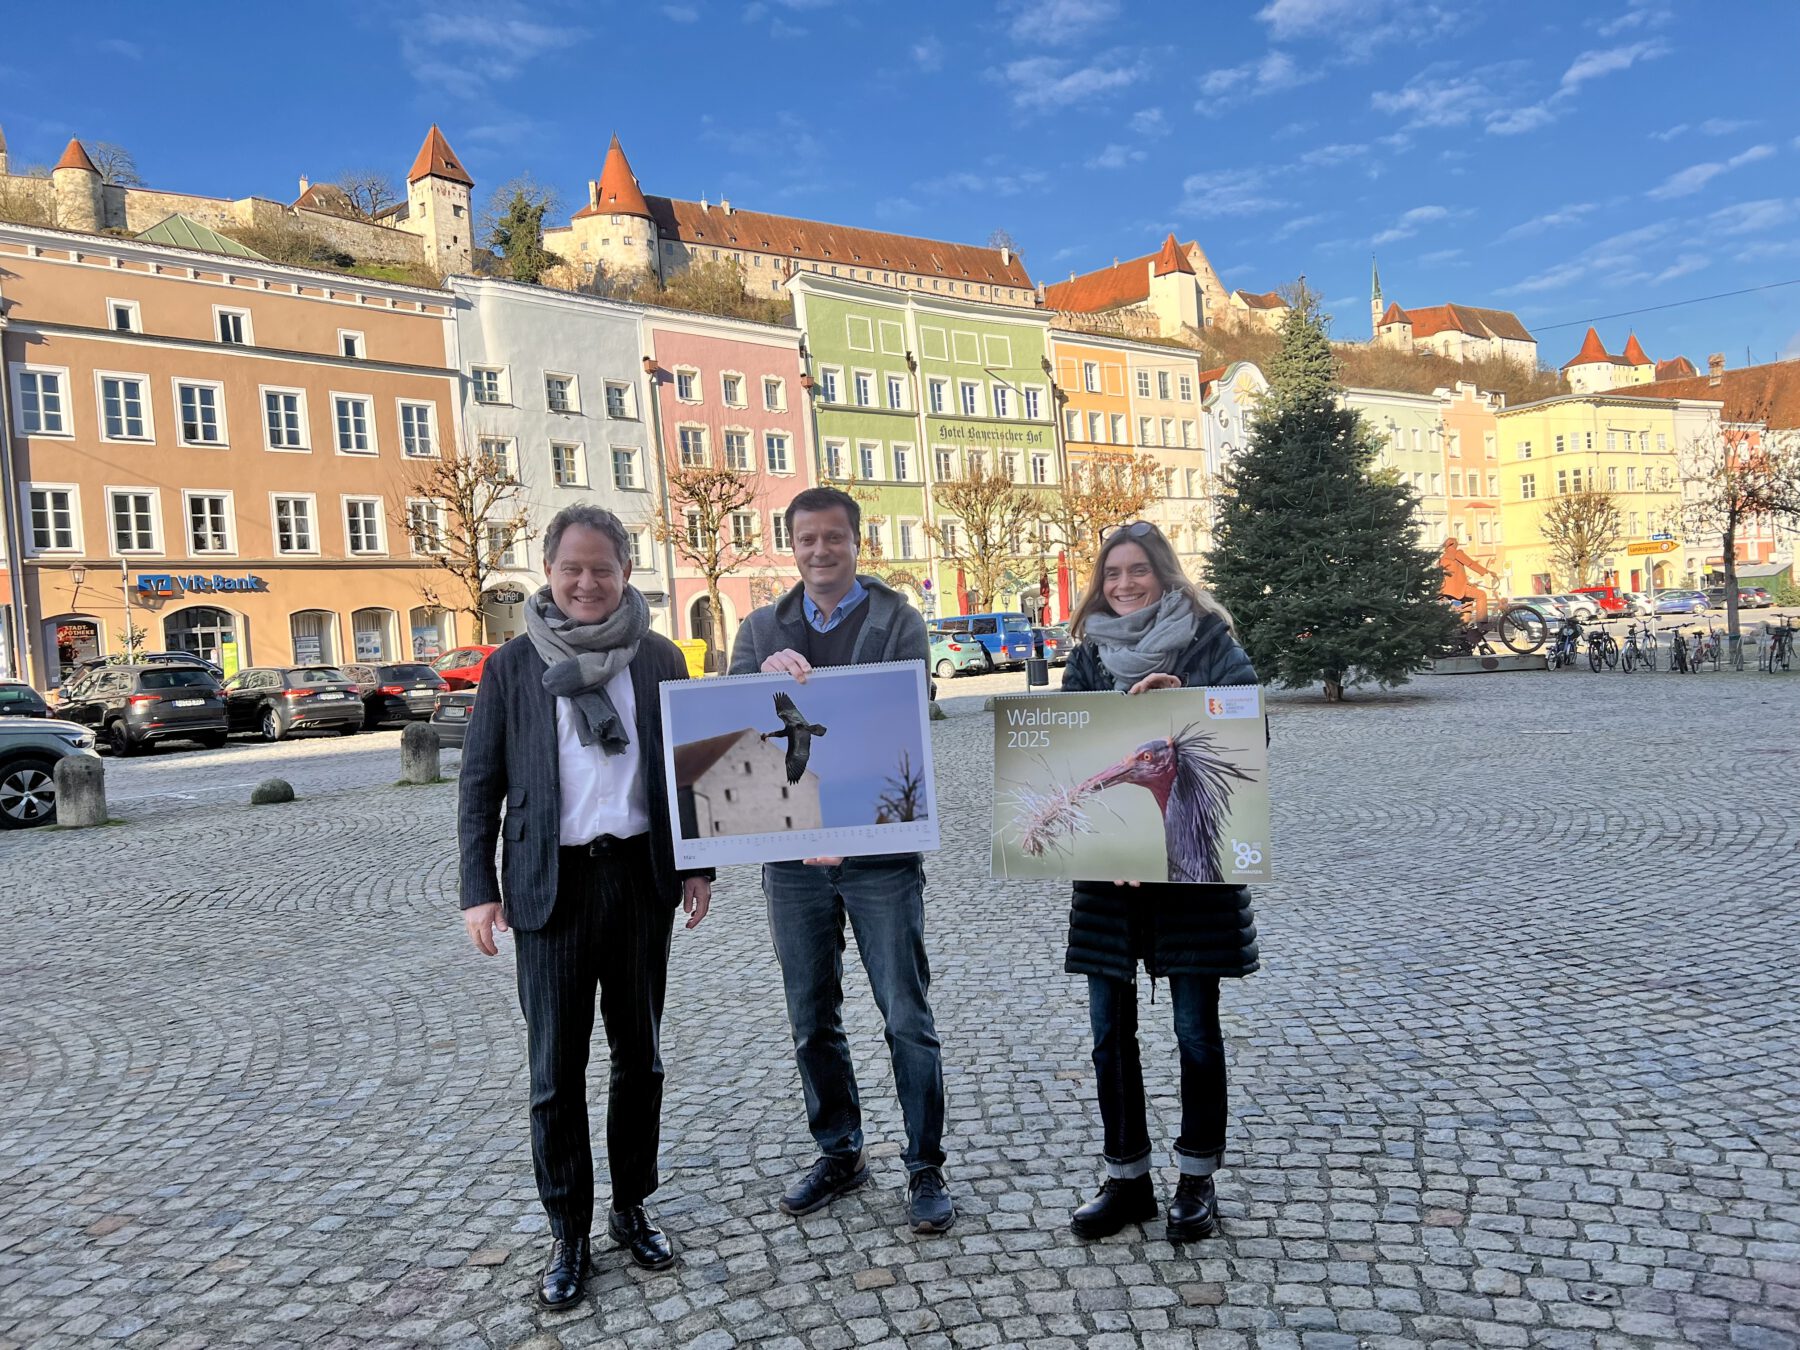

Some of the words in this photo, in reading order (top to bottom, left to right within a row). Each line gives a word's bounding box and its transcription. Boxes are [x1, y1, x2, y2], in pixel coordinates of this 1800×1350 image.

[940, 424, 964, 440] Hotel
[968, 427, 1023, 442] Bayerischer
[1027, 430, 1042, 444] Hof
[177, 573, 260, 590] VR-Bank
[1006, 707, 1090, 728] Waldrapp
[1007, 730, 1050, 748] 2025
